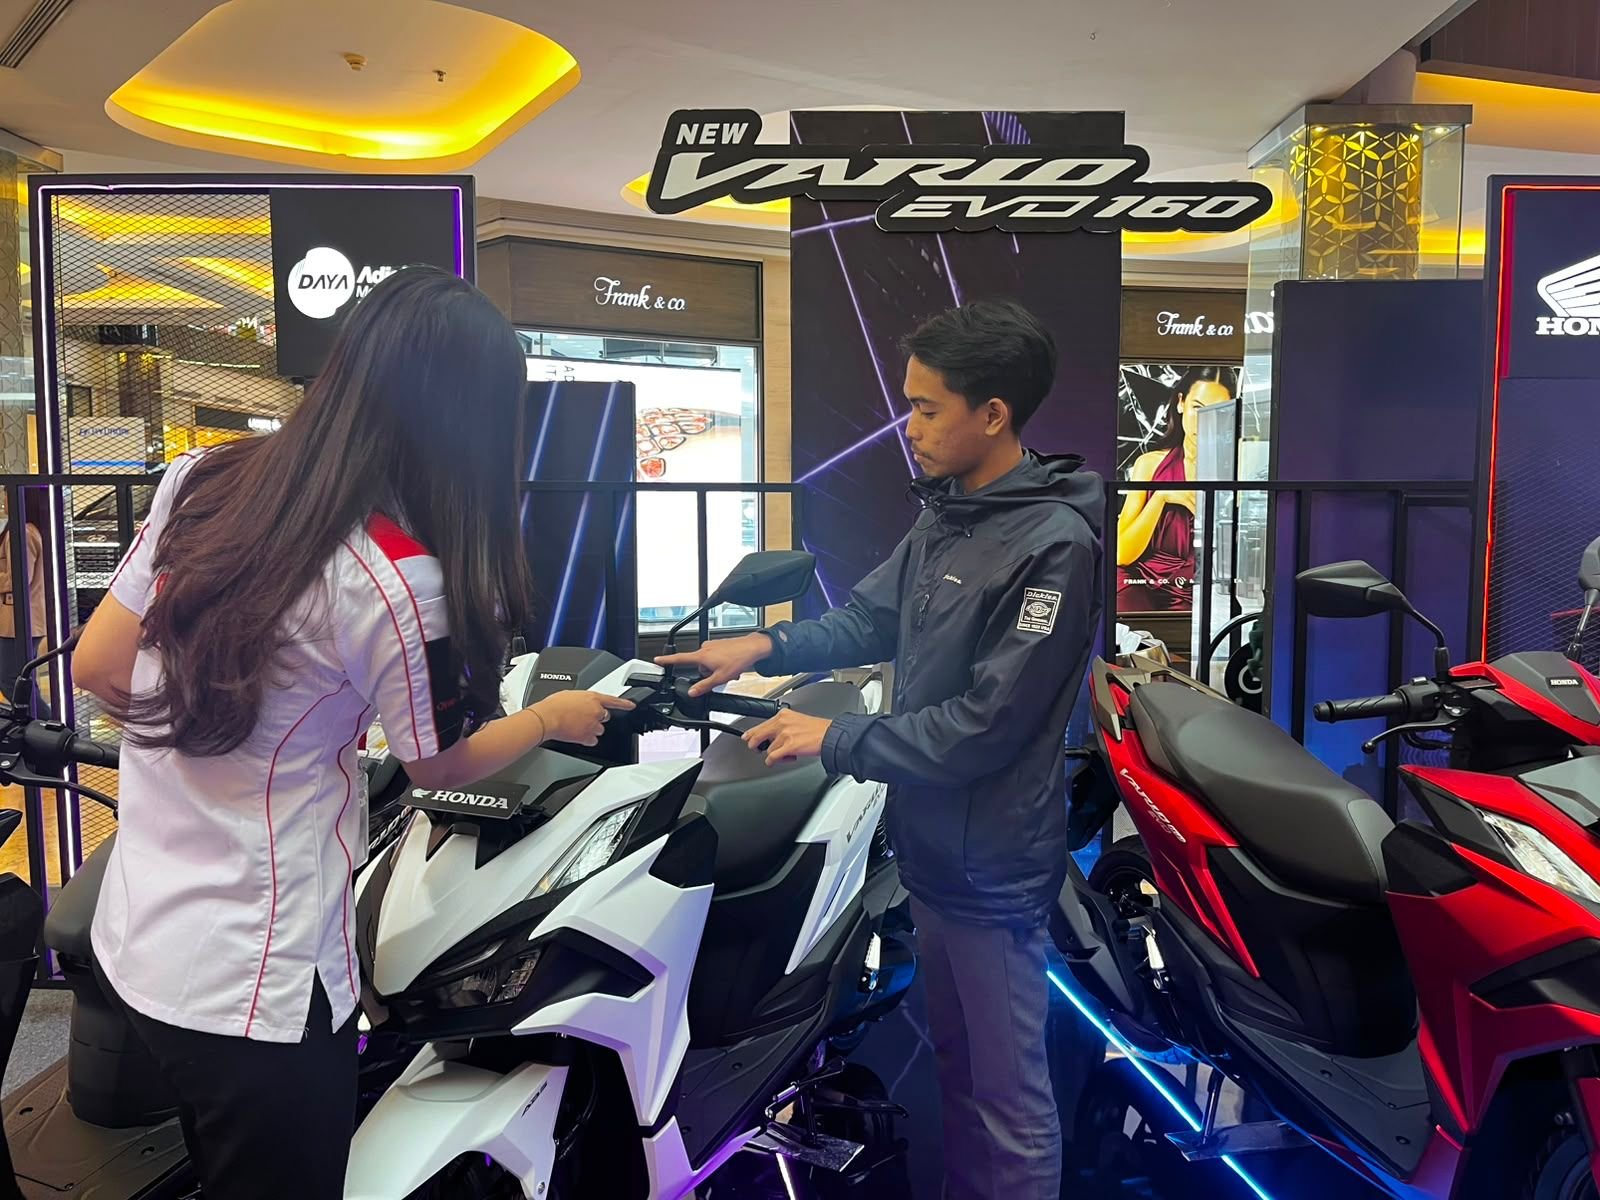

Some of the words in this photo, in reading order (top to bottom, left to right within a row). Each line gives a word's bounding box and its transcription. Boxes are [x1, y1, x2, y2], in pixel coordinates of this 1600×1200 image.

[676, 123, 748, 145] NEW
[660, 152, 1136, 199] VARIO
[890, 195, 1099, 218] EVO
[1093, 195, 1260, 218] 160
[298, 274, 348, 289] DAYA
[594, 277, 652, 309] Frank
[654, 296, 665, 309] &
[1157, 311, 1205, 336] Frank
[1206, 324, 1217, 335] &
[540, 673, 572, 681] HONDA
[431, 790, 508, 809] HONDA
